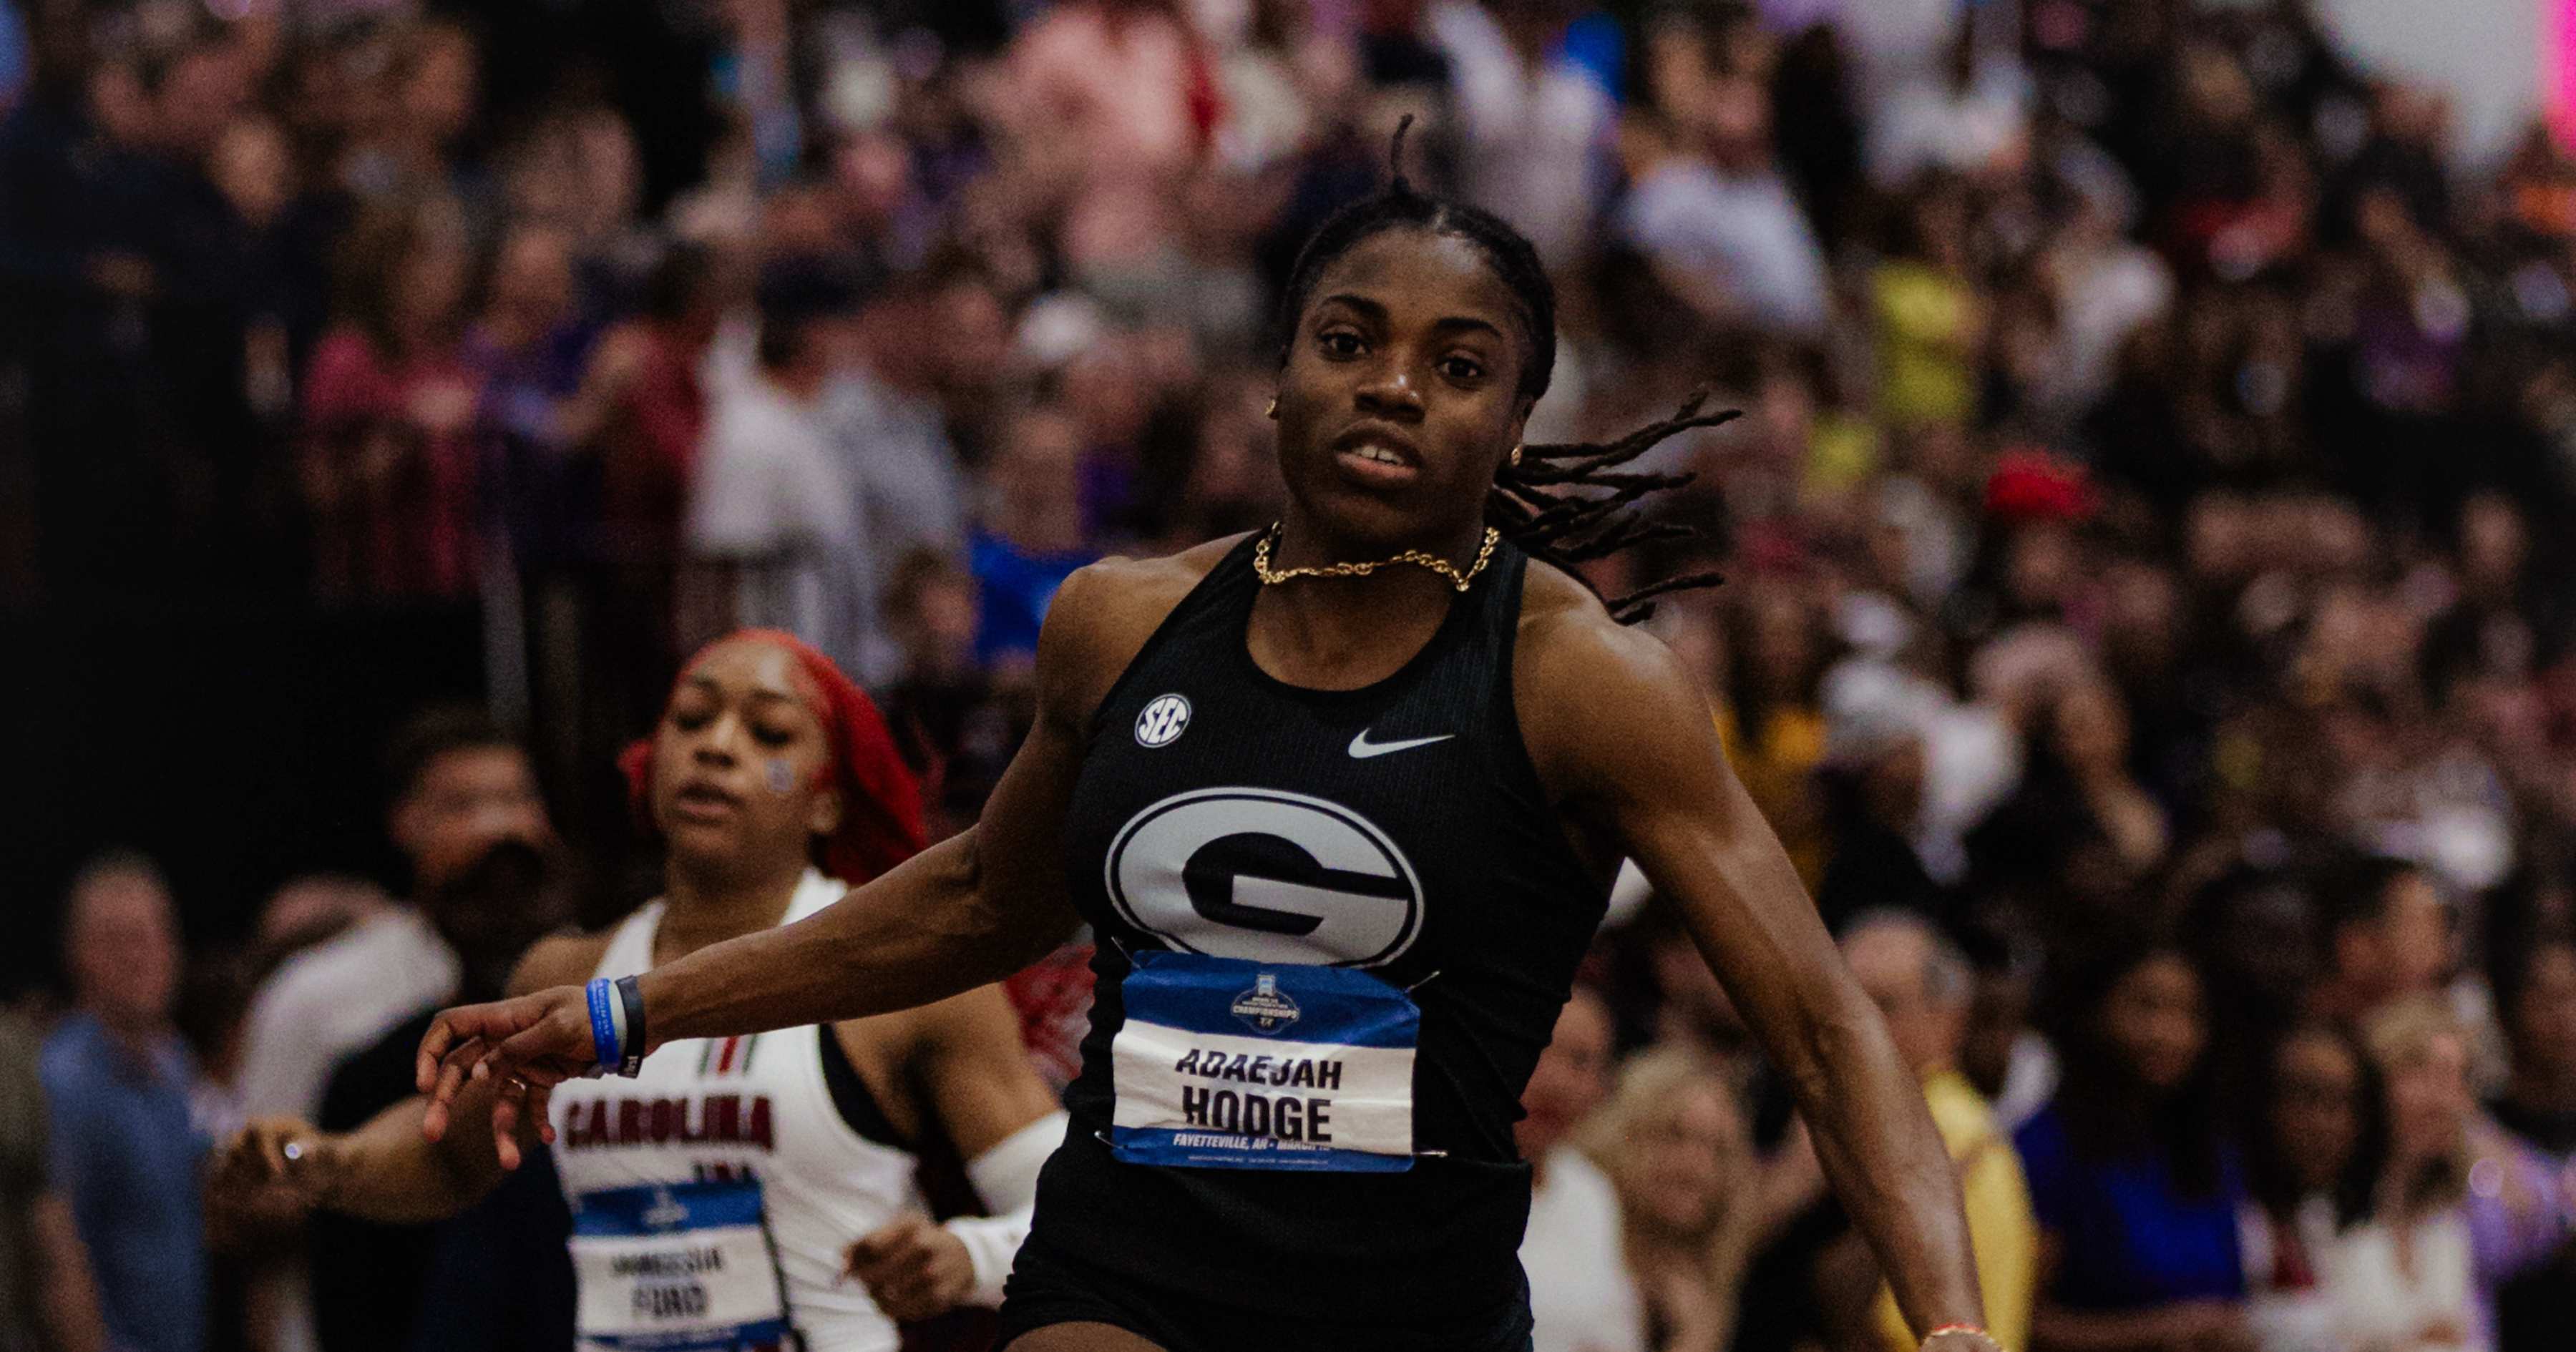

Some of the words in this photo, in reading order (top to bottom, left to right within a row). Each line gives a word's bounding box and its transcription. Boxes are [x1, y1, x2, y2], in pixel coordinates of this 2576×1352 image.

[1138, 697, 1188, 744] SEC
[1118, 799, 1410, 966] G
[1174, 1049, 1343, 1091] ADAEJAH
[1182, 1085, 1333, 1142] HODGE
[1173, 1133, 1249, 1150] FAYETTEVILLE,
